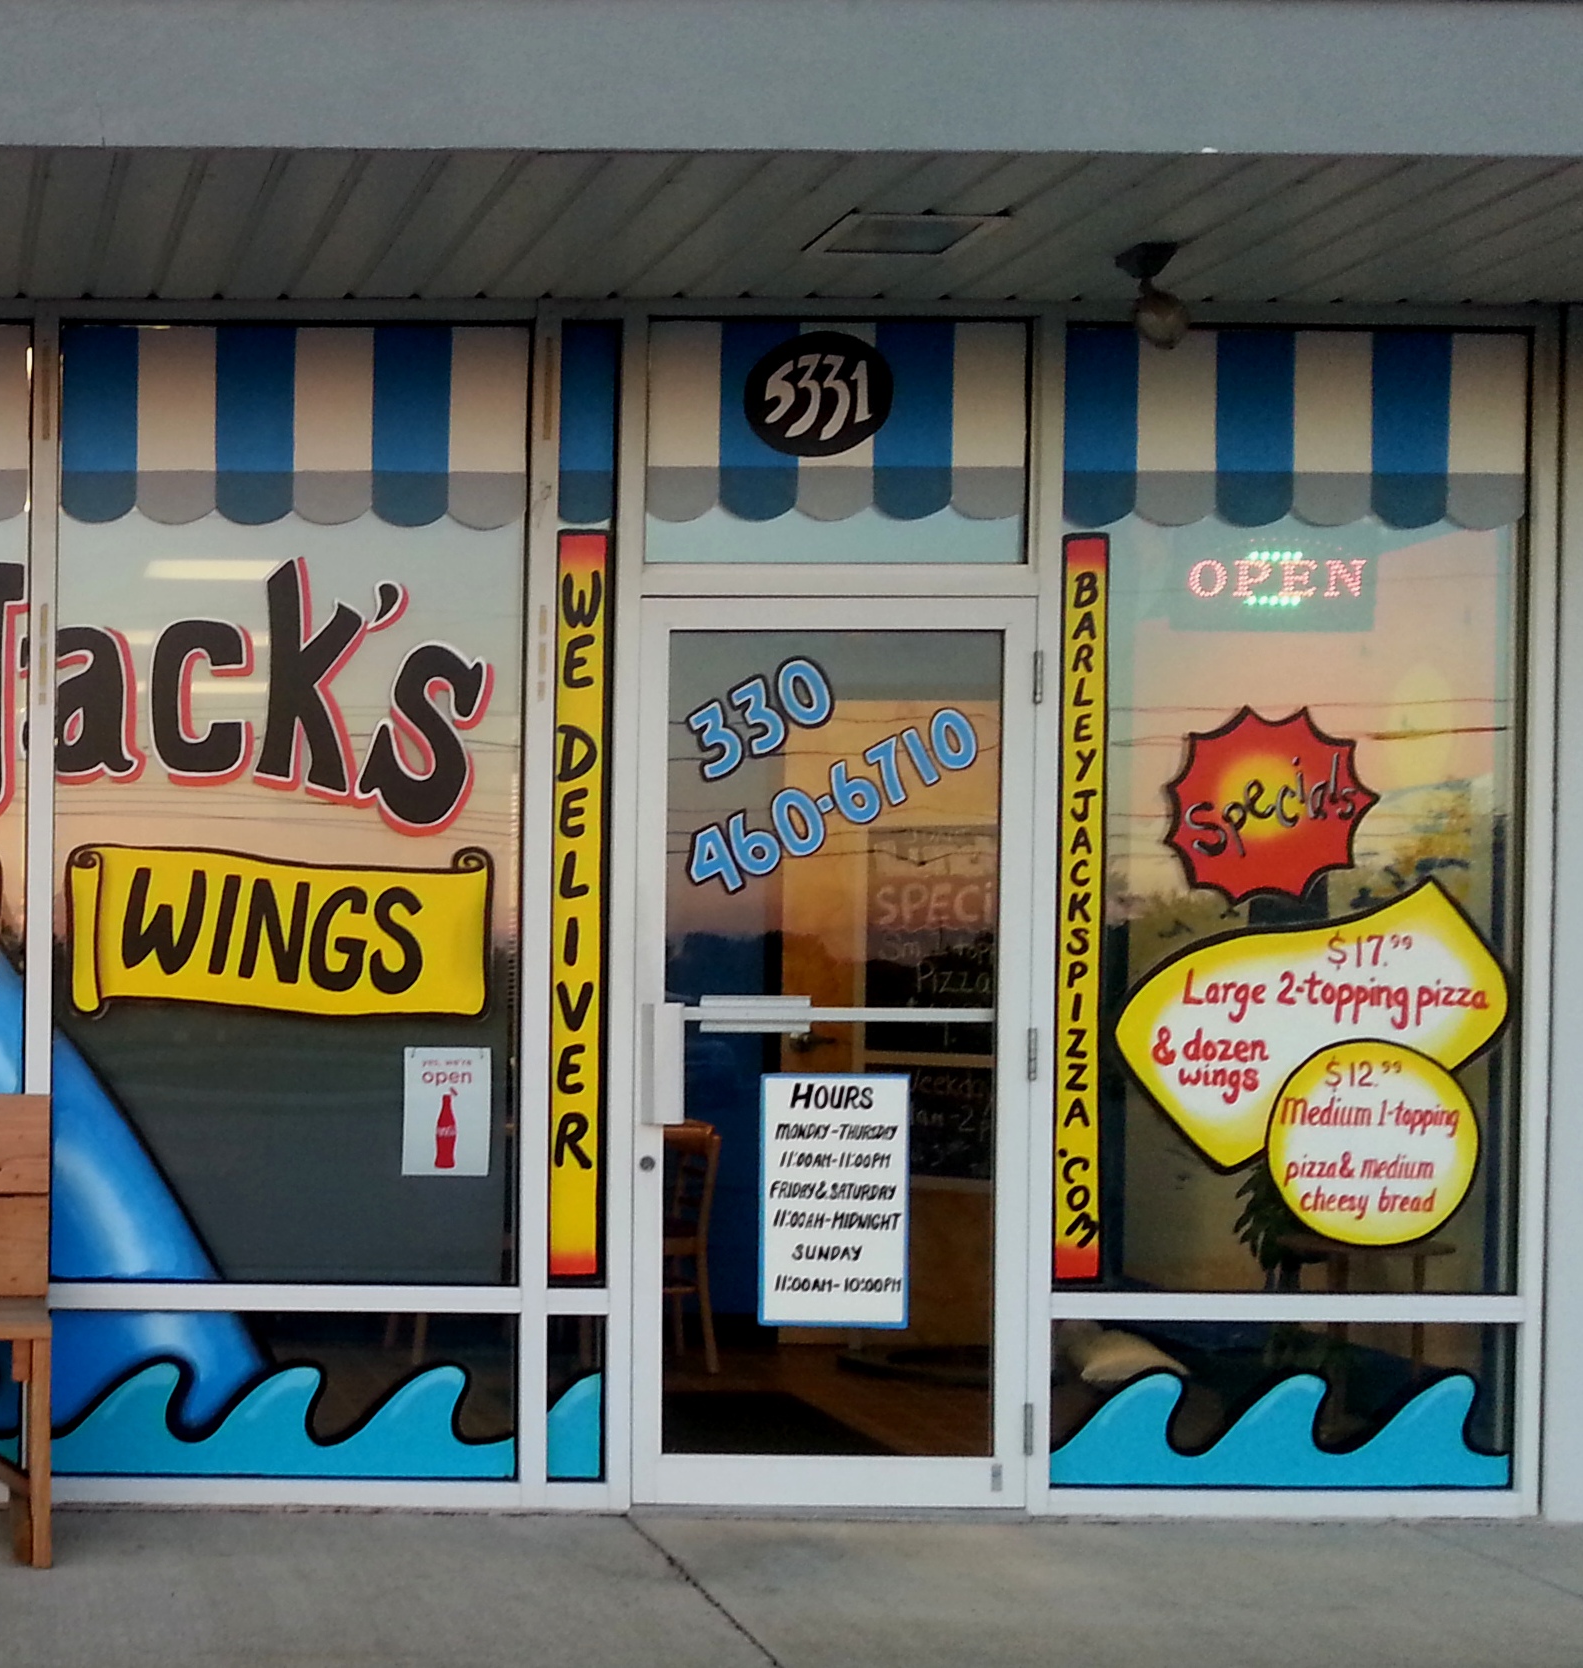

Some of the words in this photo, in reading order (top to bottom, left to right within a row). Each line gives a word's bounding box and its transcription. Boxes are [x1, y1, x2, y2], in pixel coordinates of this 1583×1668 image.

[764, 353, 874, 441] 5331
[1187, 558, 1368, 600] OPEN
[561, 569, 603, 690] WE
[685, 655, 836, 782] 330
[684, 706, 980, 894] 460-6710
[1184, 752, 1357, 858] Specials
[121, 865, 424, 994] WINGS
[553, 722, 600, 1171] DELIVER
[1182, 968, 1266, 1022] Large
[1276, 970, 1409, 1029] 2-topping
[1415, 980, 1490, 1026] pizza
[1151, 1026, 1176, 1066] &
[1182, 1029, 1268, 1063] dozen
[422, 1071, 473, 1086] open
[789, 1083, 874, 1110] HOURS
[1178, 1066, 1259, 1104] wings
[1280, 1097, 1371, 1126] Medium
[1378, 1099, 1460, 1137] 1-topping
[1285, 1160, 1336, 1186] pizza
[1339, 1152, 1353, 1179] &
[1361, 1156, 1434, 1179] medium
[770, 1180, 816, 1200] FRIDAY
[830, 1182, 897, 1200] SATURDAY
[1300, 1187, 1369, 1219] cheesy
[1378, 1188, 1435, 1214] bread
[792, 1244, 862, 1261] SUNDAY
